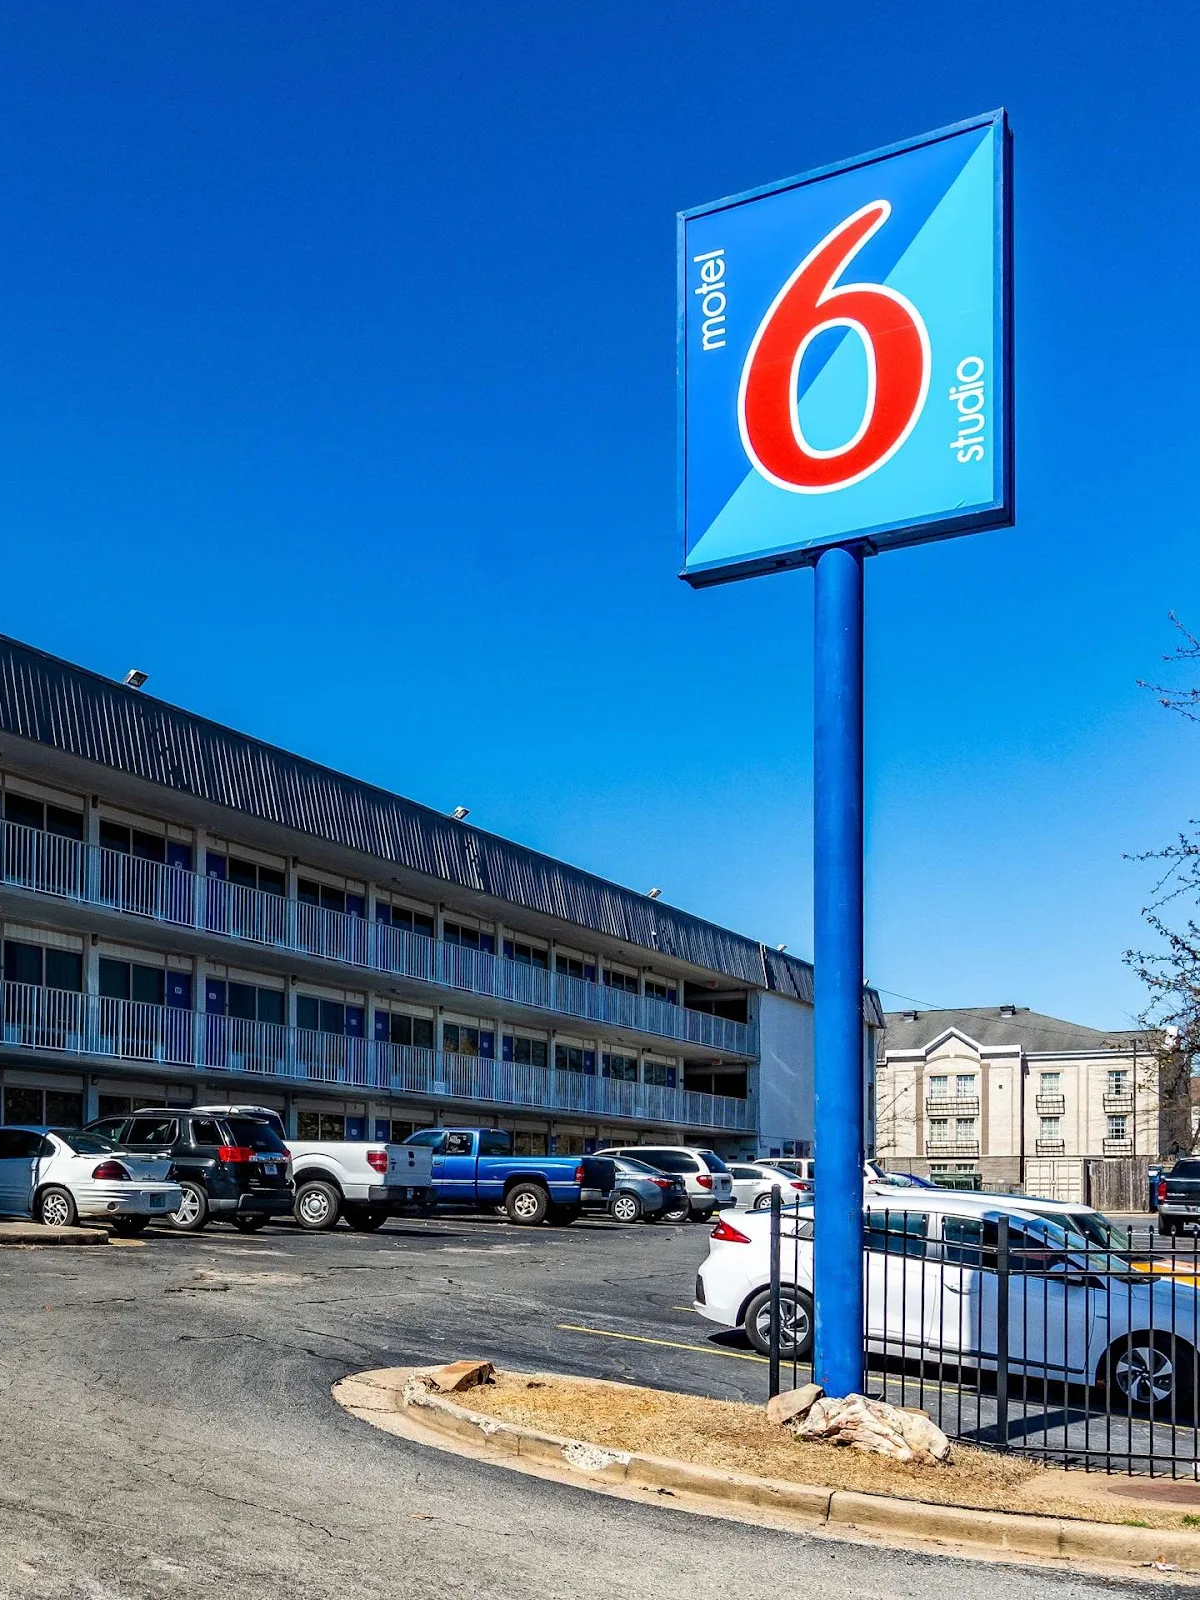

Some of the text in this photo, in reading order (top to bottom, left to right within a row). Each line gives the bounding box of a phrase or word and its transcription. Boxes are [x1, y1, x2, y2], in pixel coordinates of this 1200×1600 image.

[693, 248, 726, 352] motel
[737, 199, 932, 495] 6
[949, 355, 985, 464] studio
